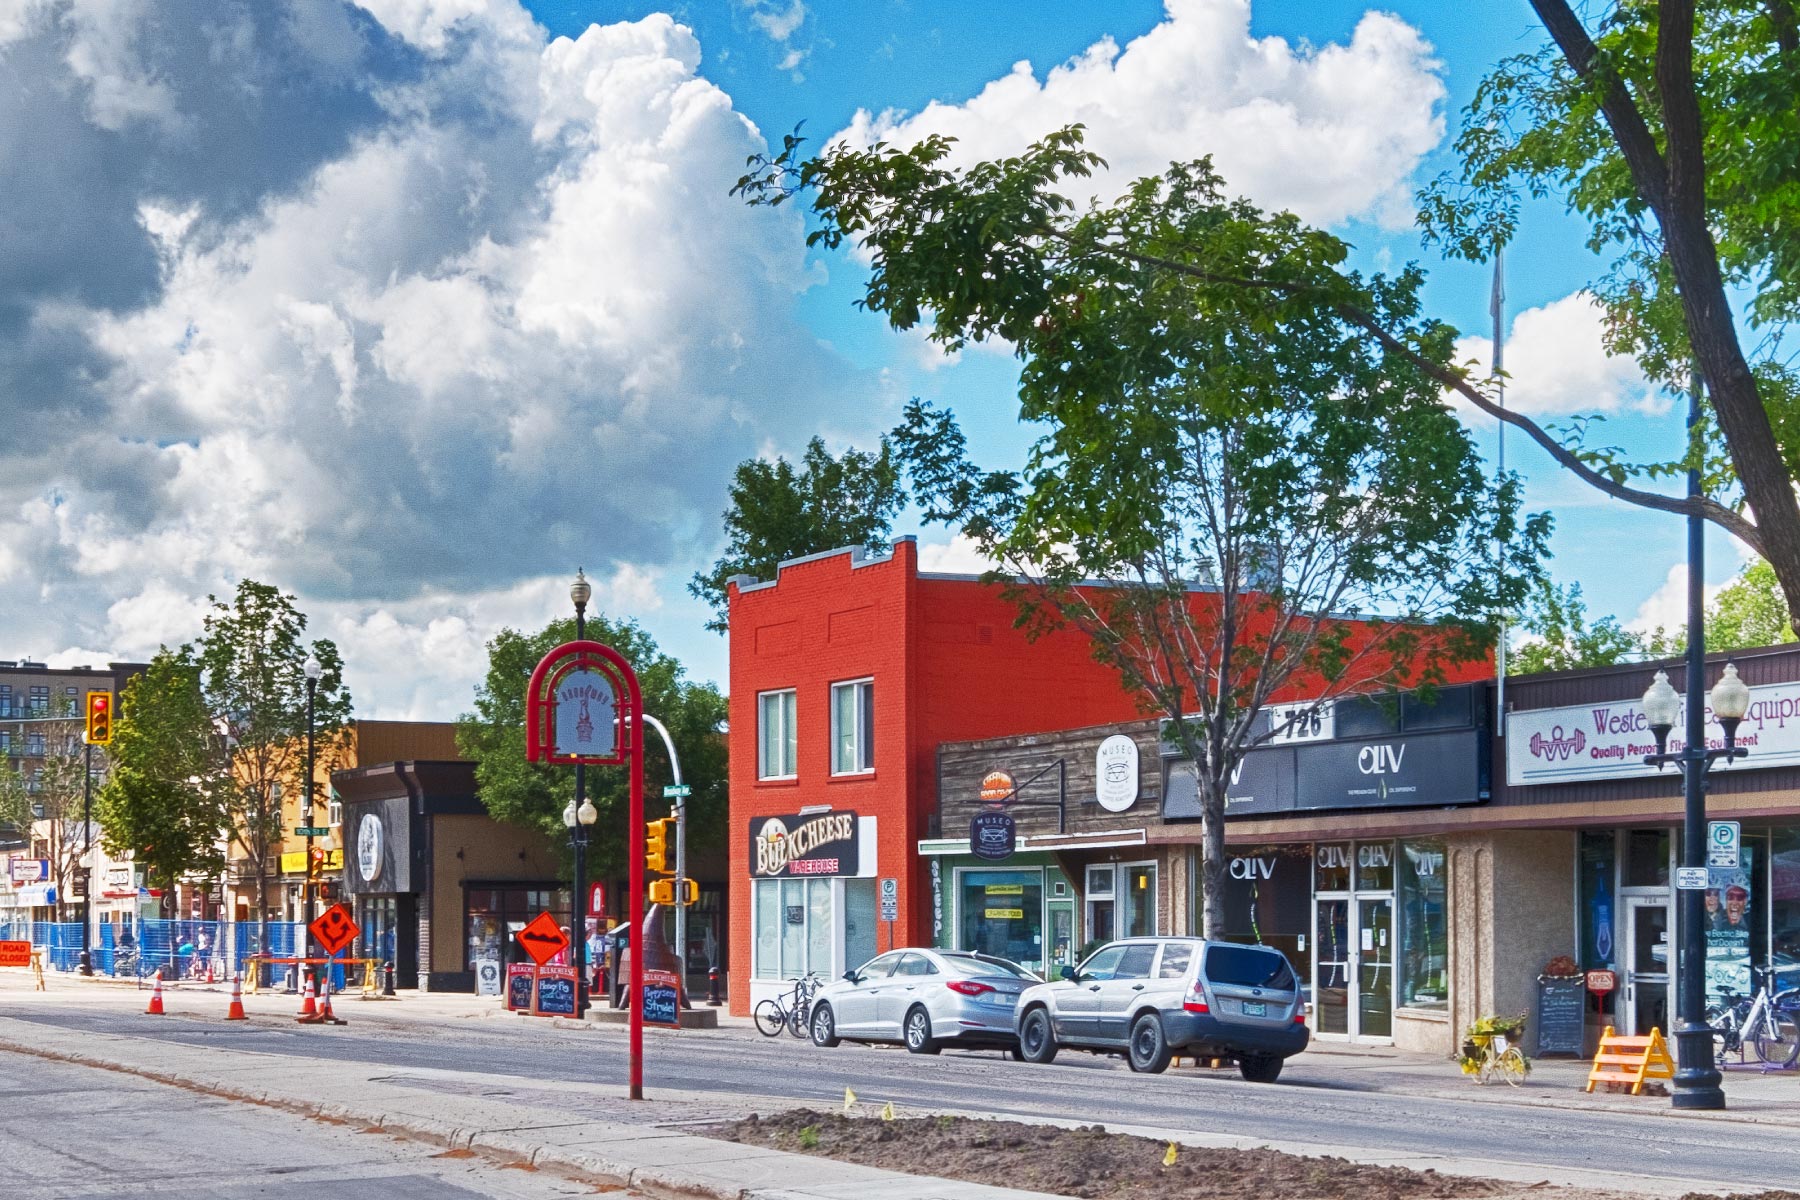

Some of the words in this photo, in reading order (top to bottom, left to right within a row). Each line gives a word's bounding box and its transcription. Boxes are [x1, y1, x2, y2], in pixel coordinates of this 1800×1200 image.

[1284, 707, 1322, 739] 726
[1592, 706, 1657, 735] Weste
[1102, 744, 1133, 756] MUSEO
[1357, 743, 1406, 775] OLIV
[1590, 745, 1625, 760] Quality
[1627, 742, 1657, 757] Person
[977, 817, 1011, 826] MUSEO
[755, 814, 853, 876] BULKCHEESE
[788, 858, 839, 874] WAREHOUSE
[1229, 857, 1277, 880] OLIV
[3, 945, 26, 953] ROAD
[1589, 974, 1612, 984] OPEN
